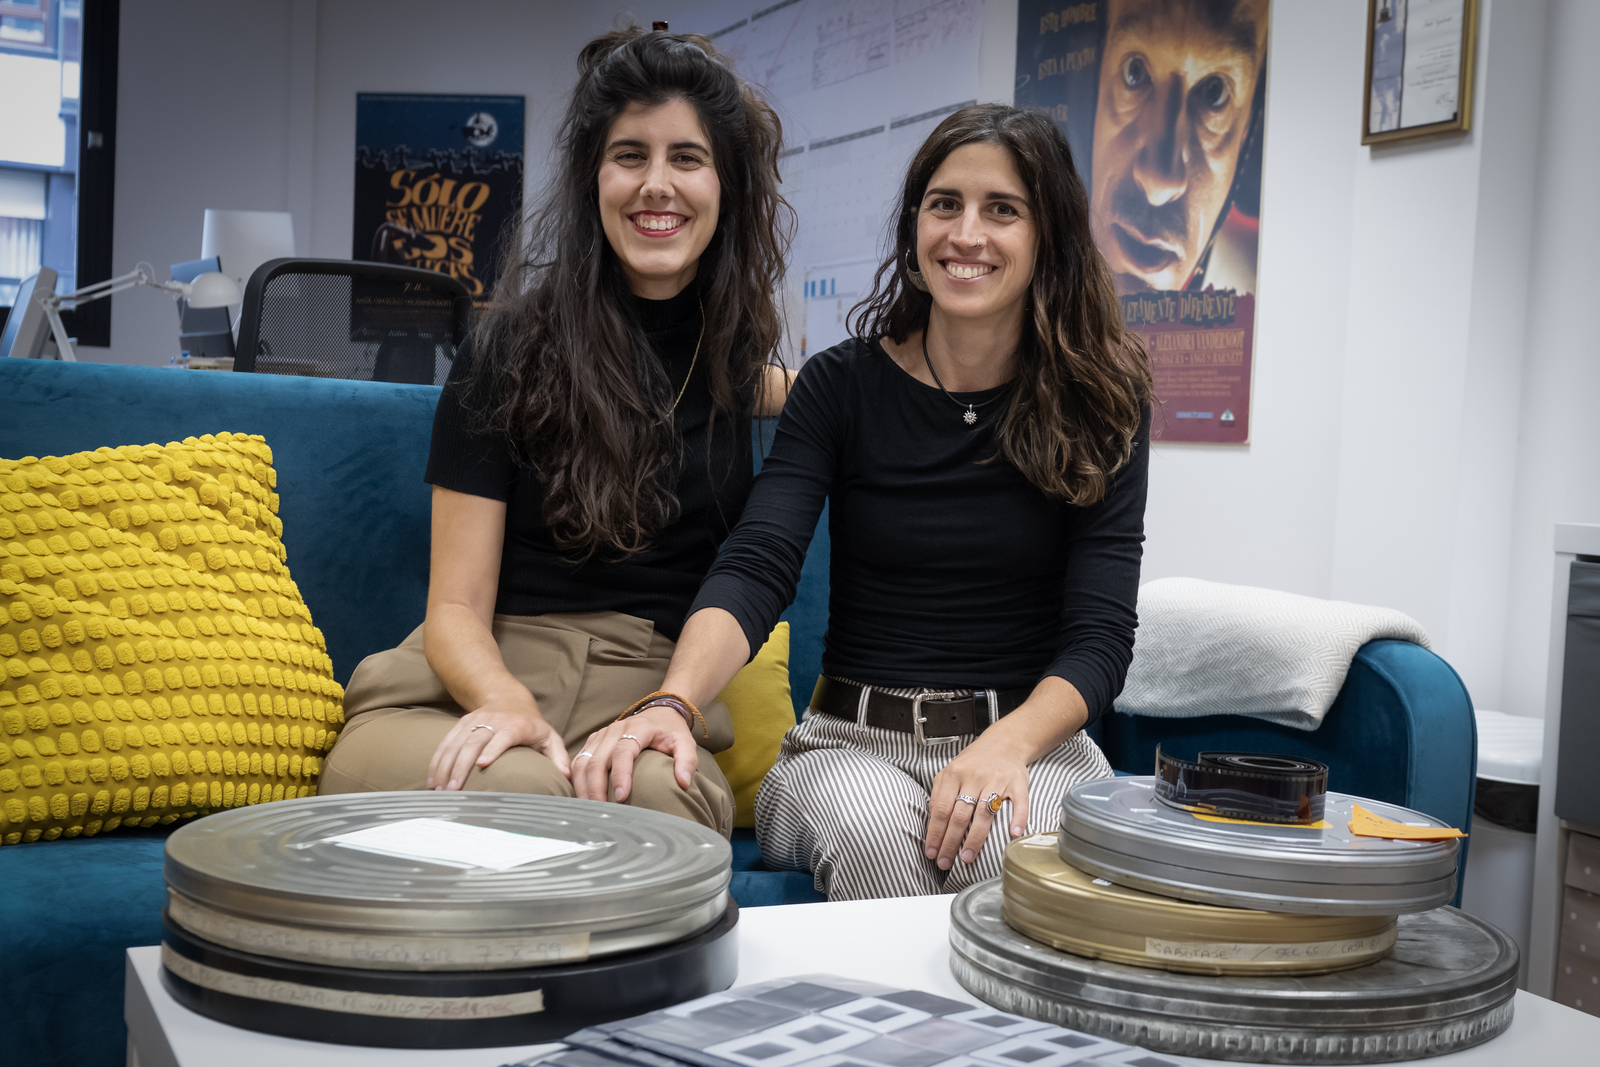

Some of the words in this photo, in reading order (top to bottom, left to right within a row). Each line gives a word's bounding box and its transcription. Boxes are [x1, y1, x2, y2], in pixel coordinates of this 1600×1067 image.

[386, 169, 491, 212] SÓLO
[410, 207, 483, 242] MUERE
[1179, 293, 1236, 322] DIFERENTE
